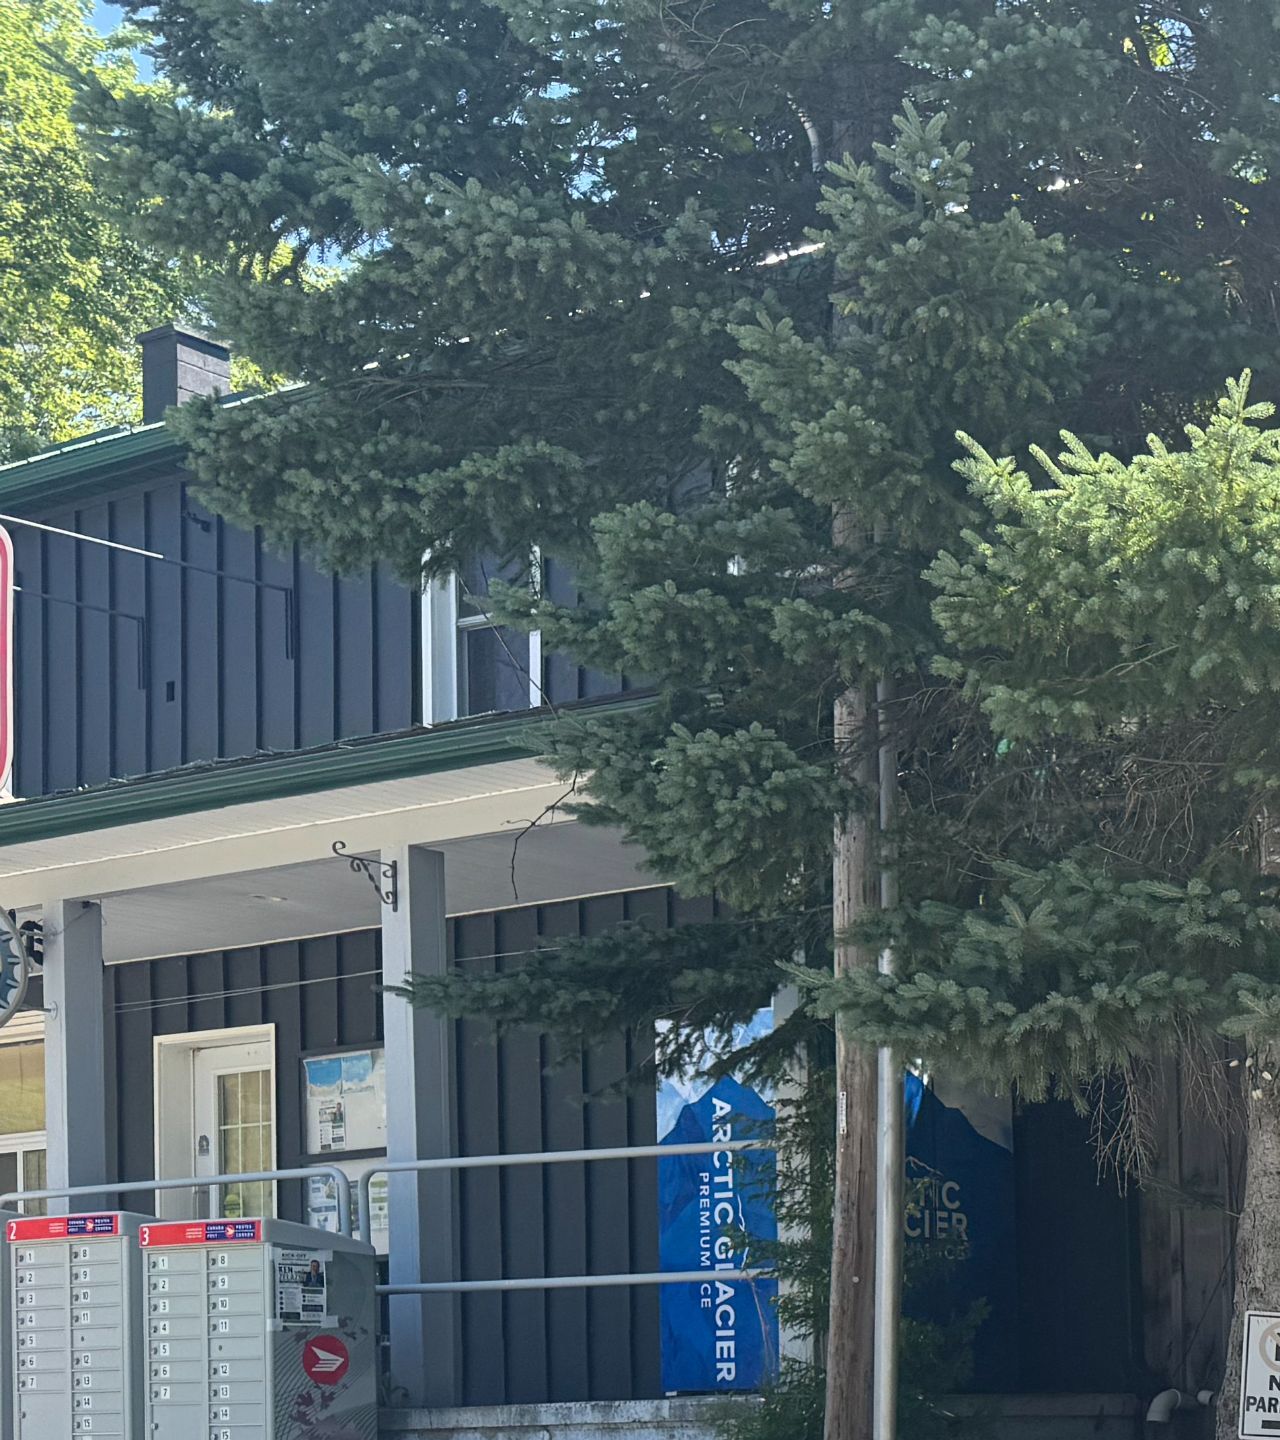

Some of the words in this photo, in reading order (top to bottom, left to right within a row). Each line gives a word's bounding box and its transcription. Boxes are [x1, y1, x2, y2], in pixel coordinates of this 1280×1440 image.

[711, 1096, 734, 1225] ARCTIC
[9, 1222, 17, 1240] 2
[699, 1172, 710, 1267] PREMIUM
[141, 1227, 150, 1245] 3
[700, 1282, 712, 1308] CE
